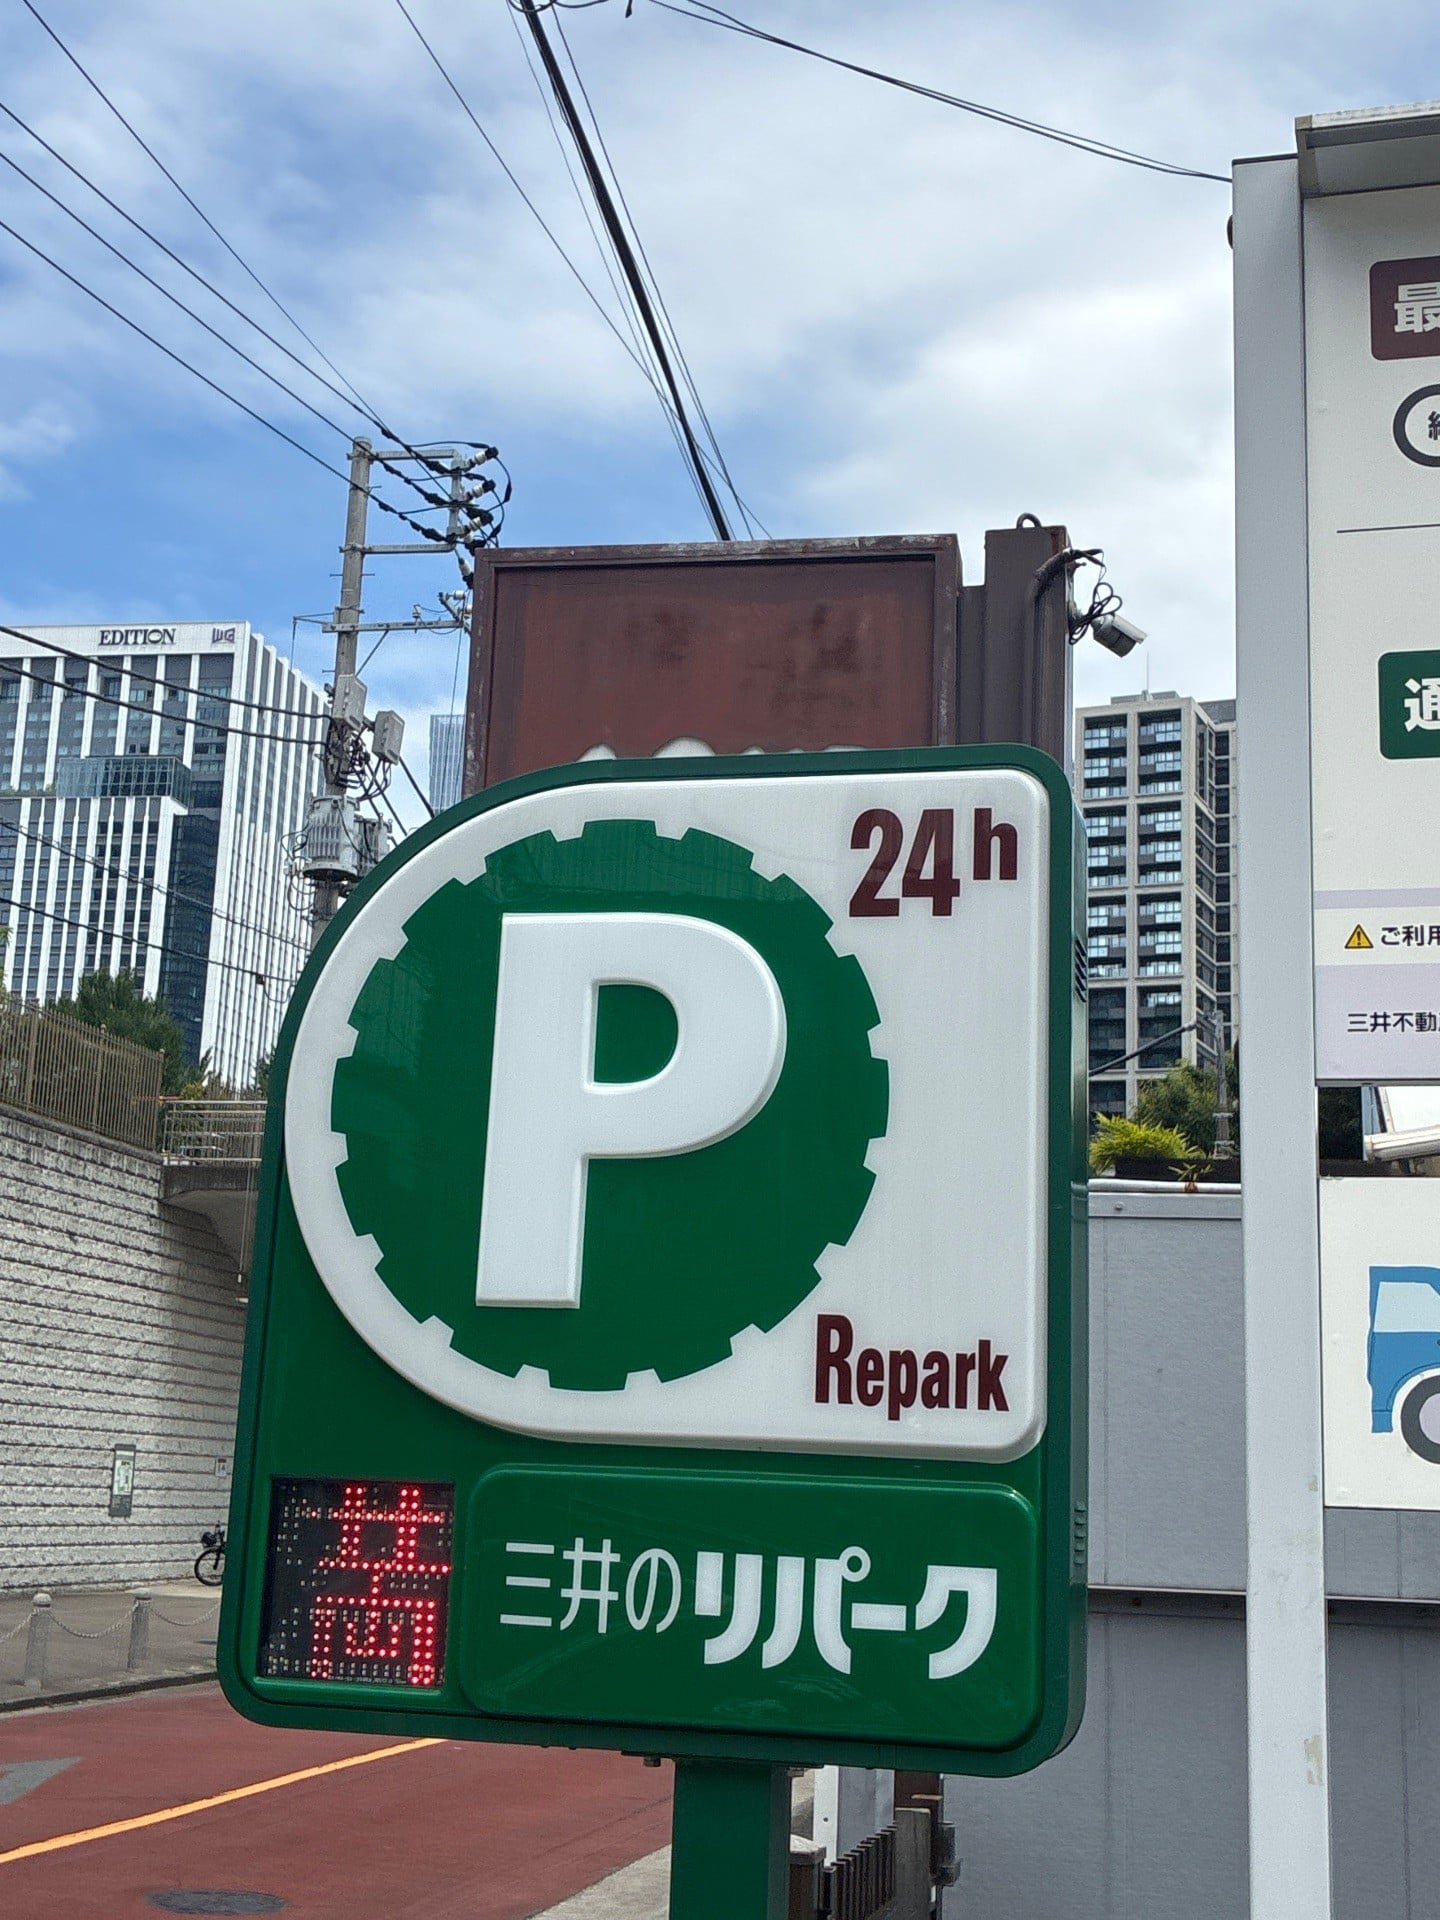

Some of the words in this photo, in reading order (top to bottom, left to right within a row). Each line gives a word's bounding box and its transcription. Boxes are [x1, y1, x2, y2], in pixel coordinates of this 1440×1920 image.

[99, 628, 176, 646] EDITION
[848, 808, 1019, 918] 24h
[1381, 924, 1440, 946] ご利用
[1347, 1012, 1440, 1033] 三井不動
[475, 912, 788, 1309] P
[815, 1314, 1009, 1421] Repark
[499, 1536, 998, 1680] 三井のリパーク
